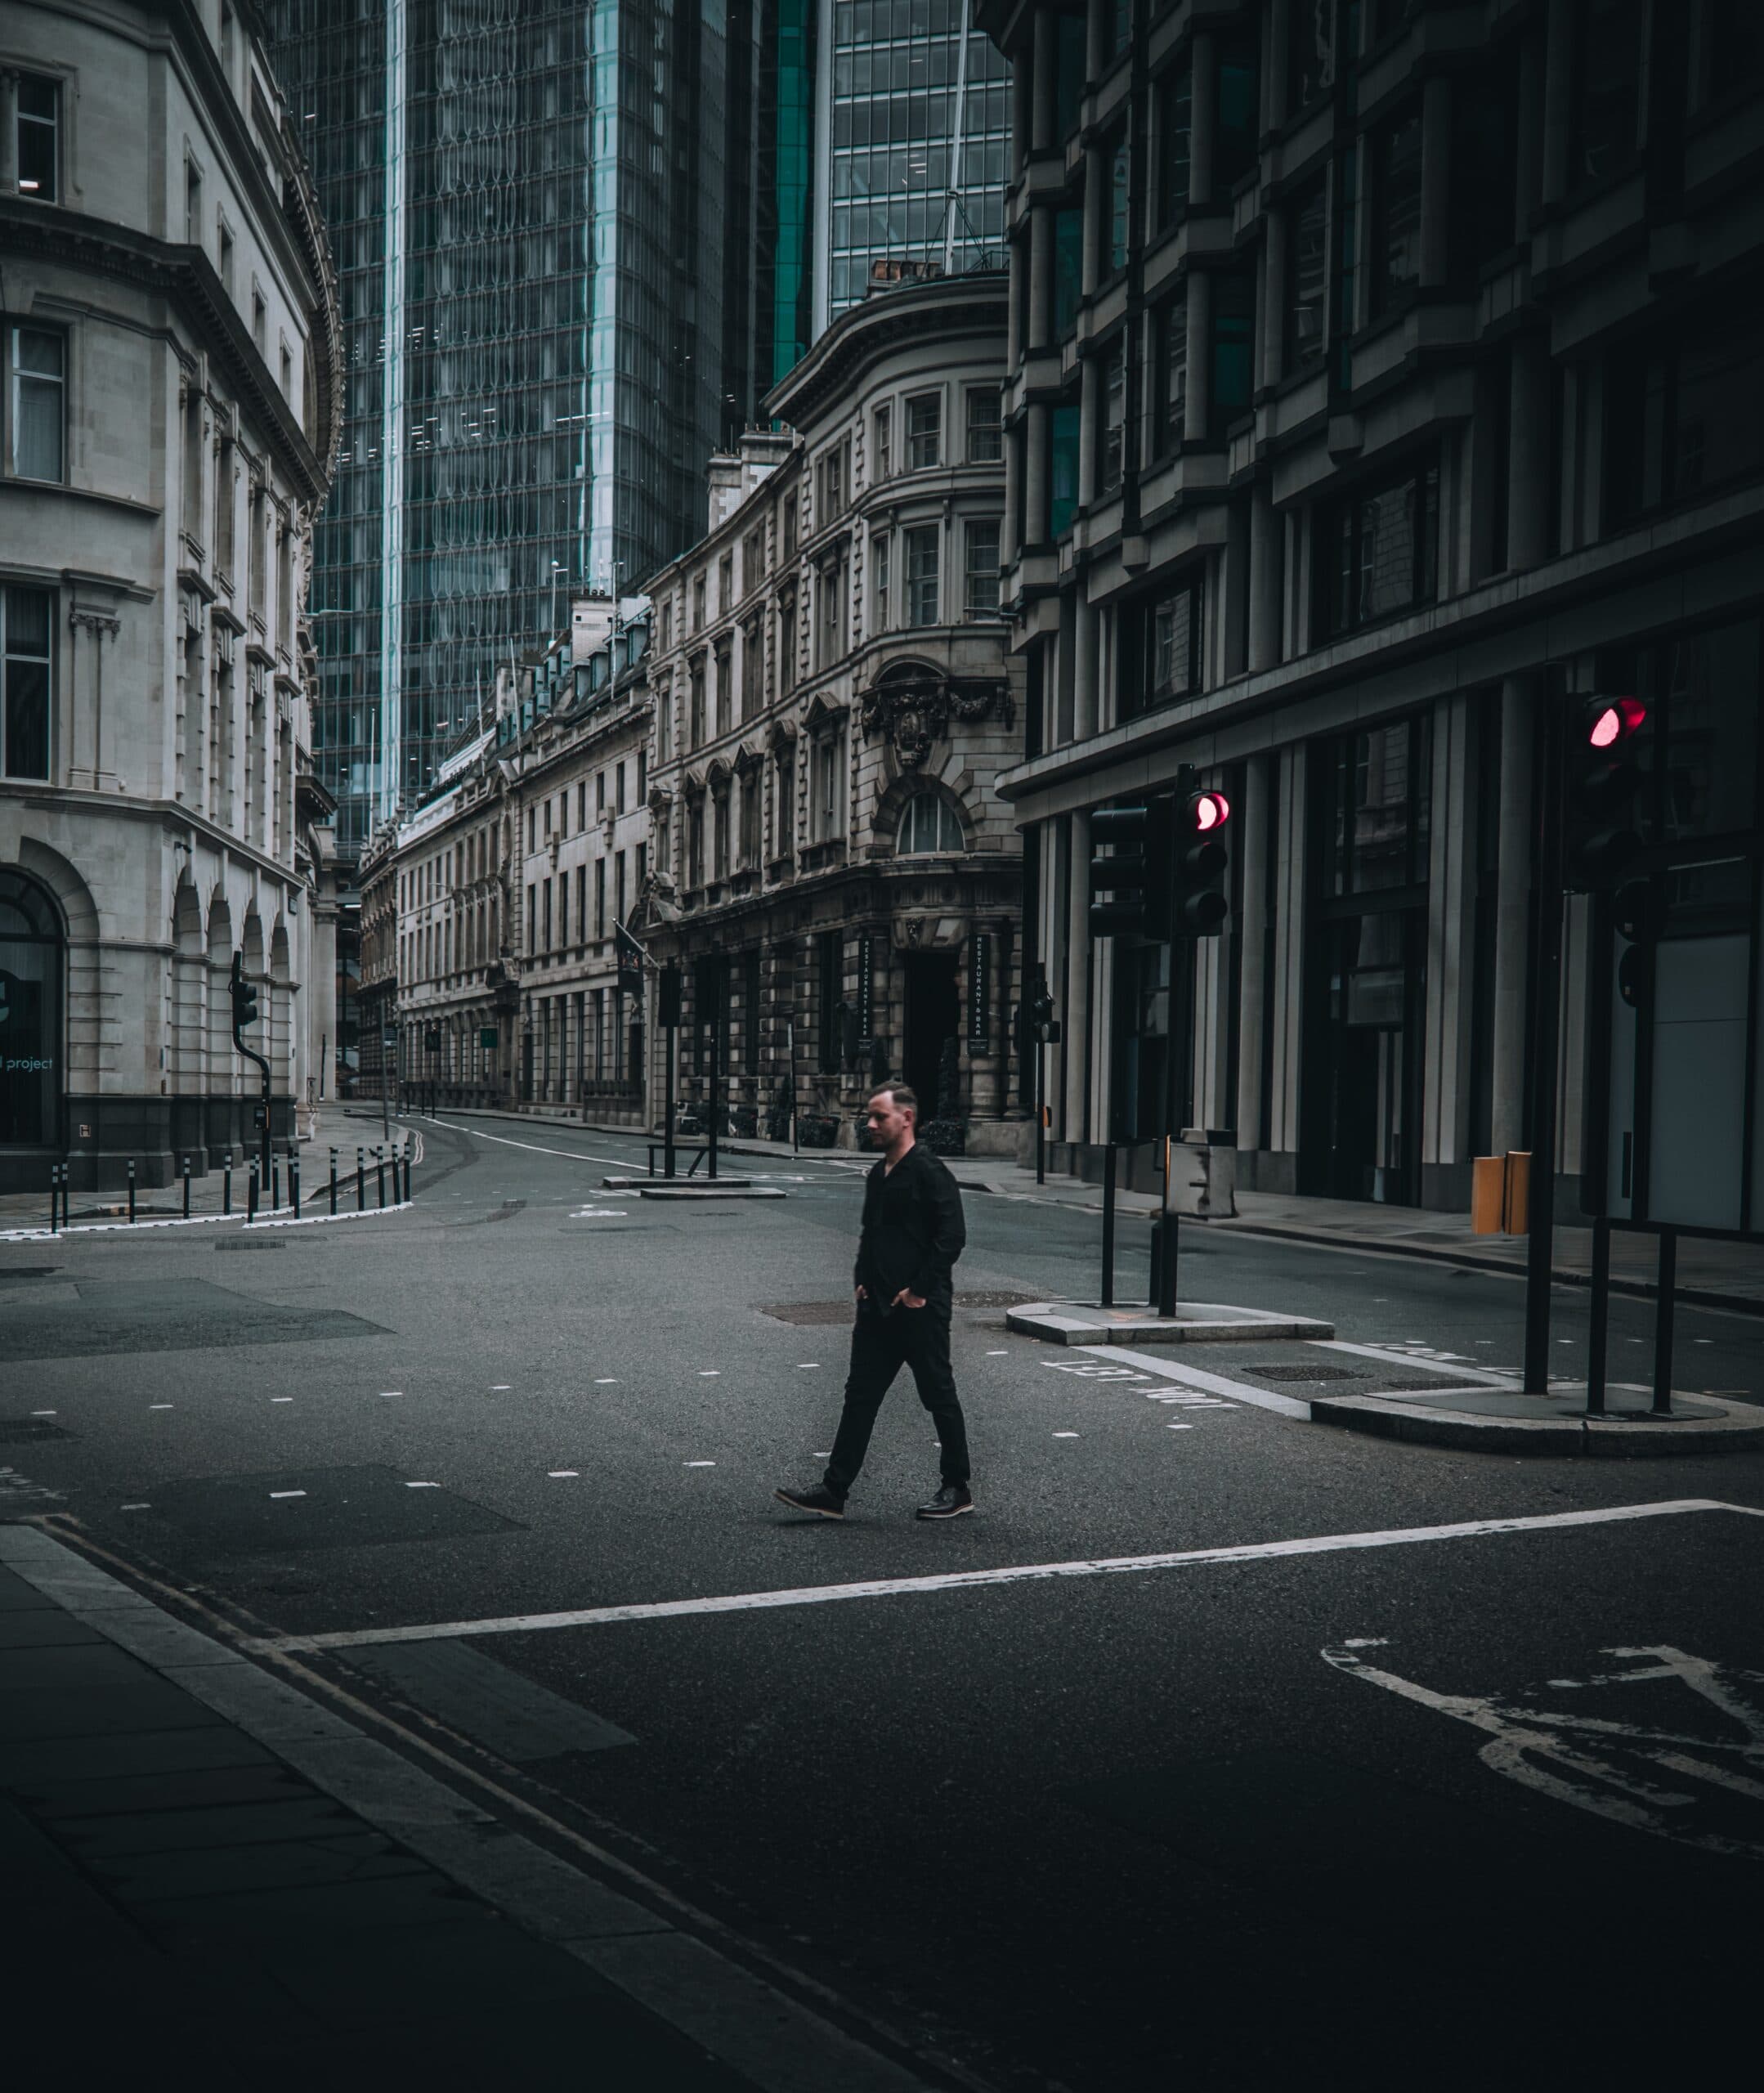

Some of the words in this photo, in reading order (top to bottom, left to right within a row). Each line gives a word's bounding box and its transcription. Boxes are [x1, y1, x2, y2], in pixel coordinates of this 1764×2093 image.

[7, 1056, 53, 1073] project
[1040, 1360, 1153, 1382] LEFT
[1128, 1386, 1242, 1410] LOOK
